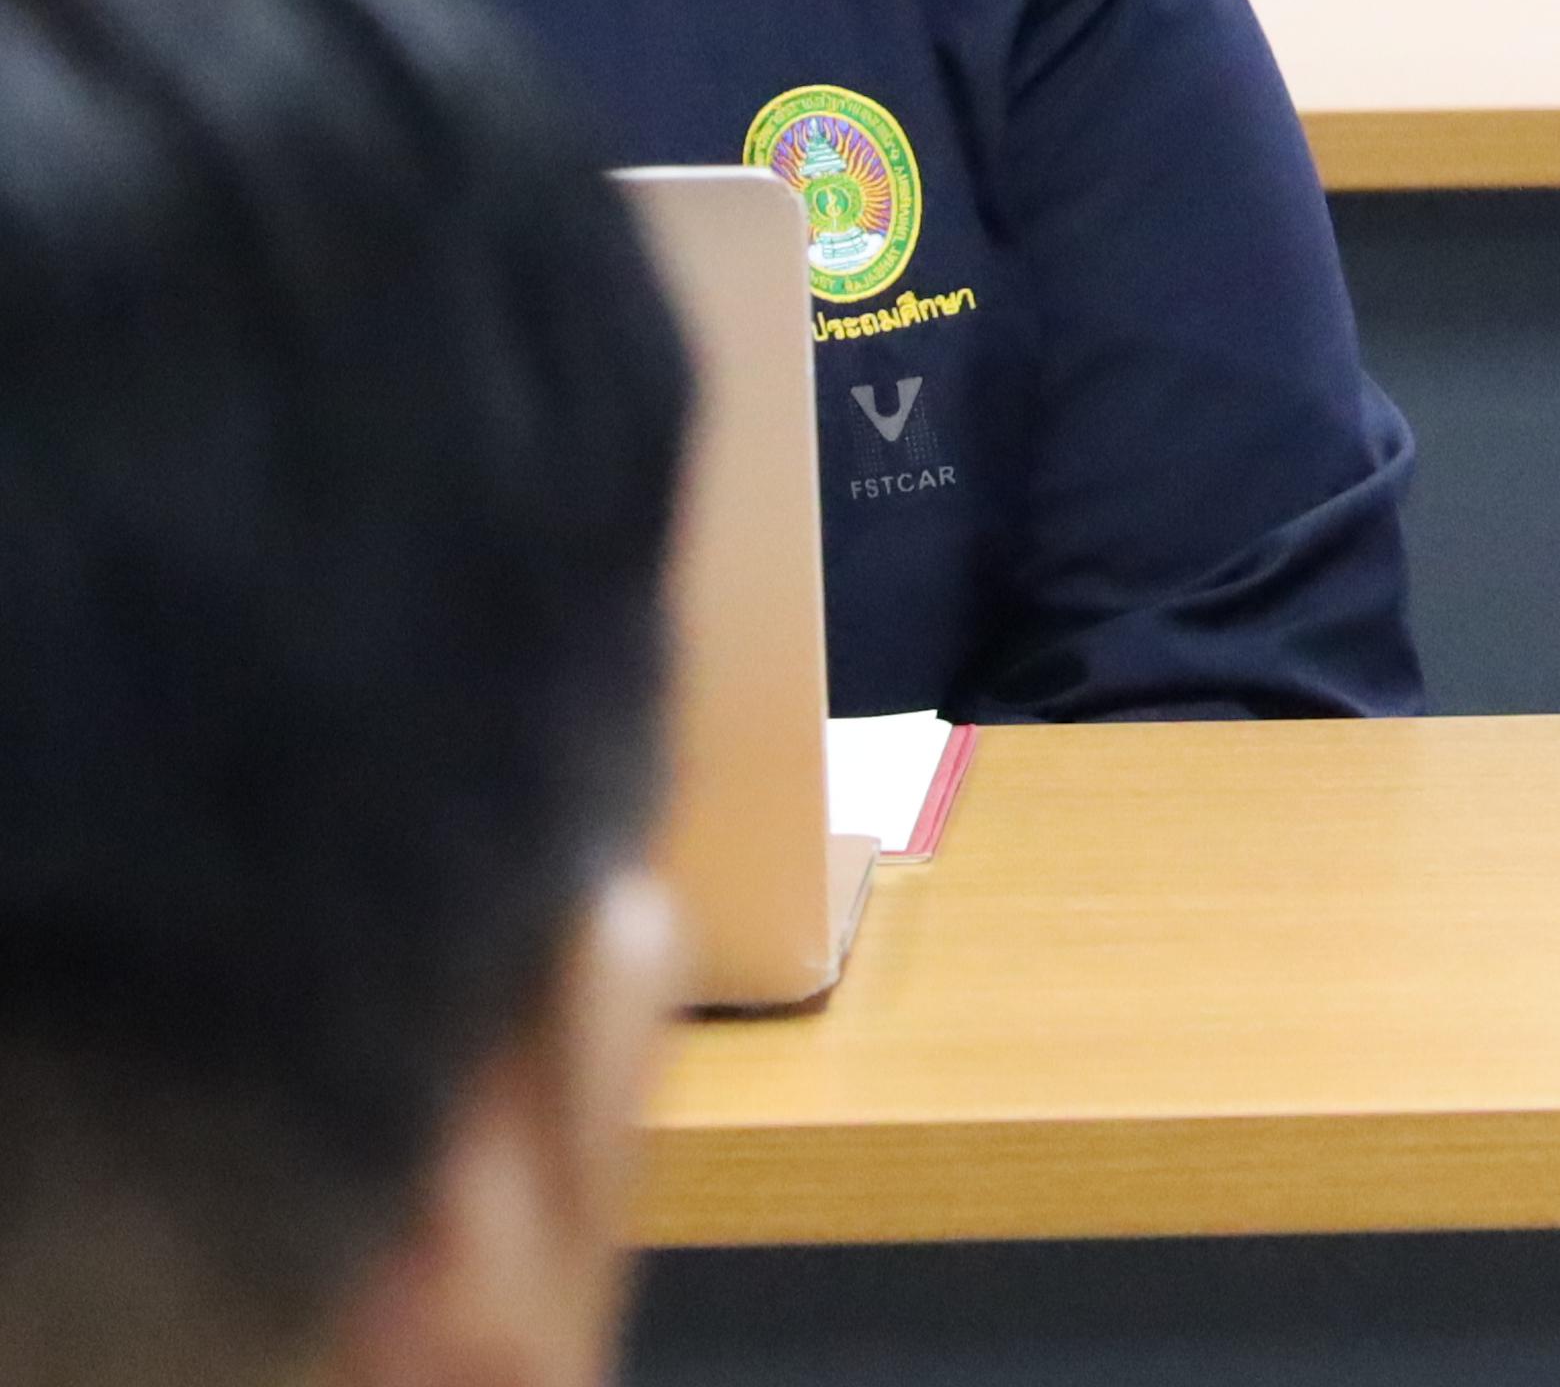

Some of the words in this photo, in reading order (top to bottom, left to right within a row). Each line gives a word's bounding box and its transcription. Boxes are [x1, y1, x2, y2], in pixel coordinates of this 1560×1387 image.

[811, 287, 977, 342] ประถมศึกษา
[851, 465, 957, 500] FSTCAR
